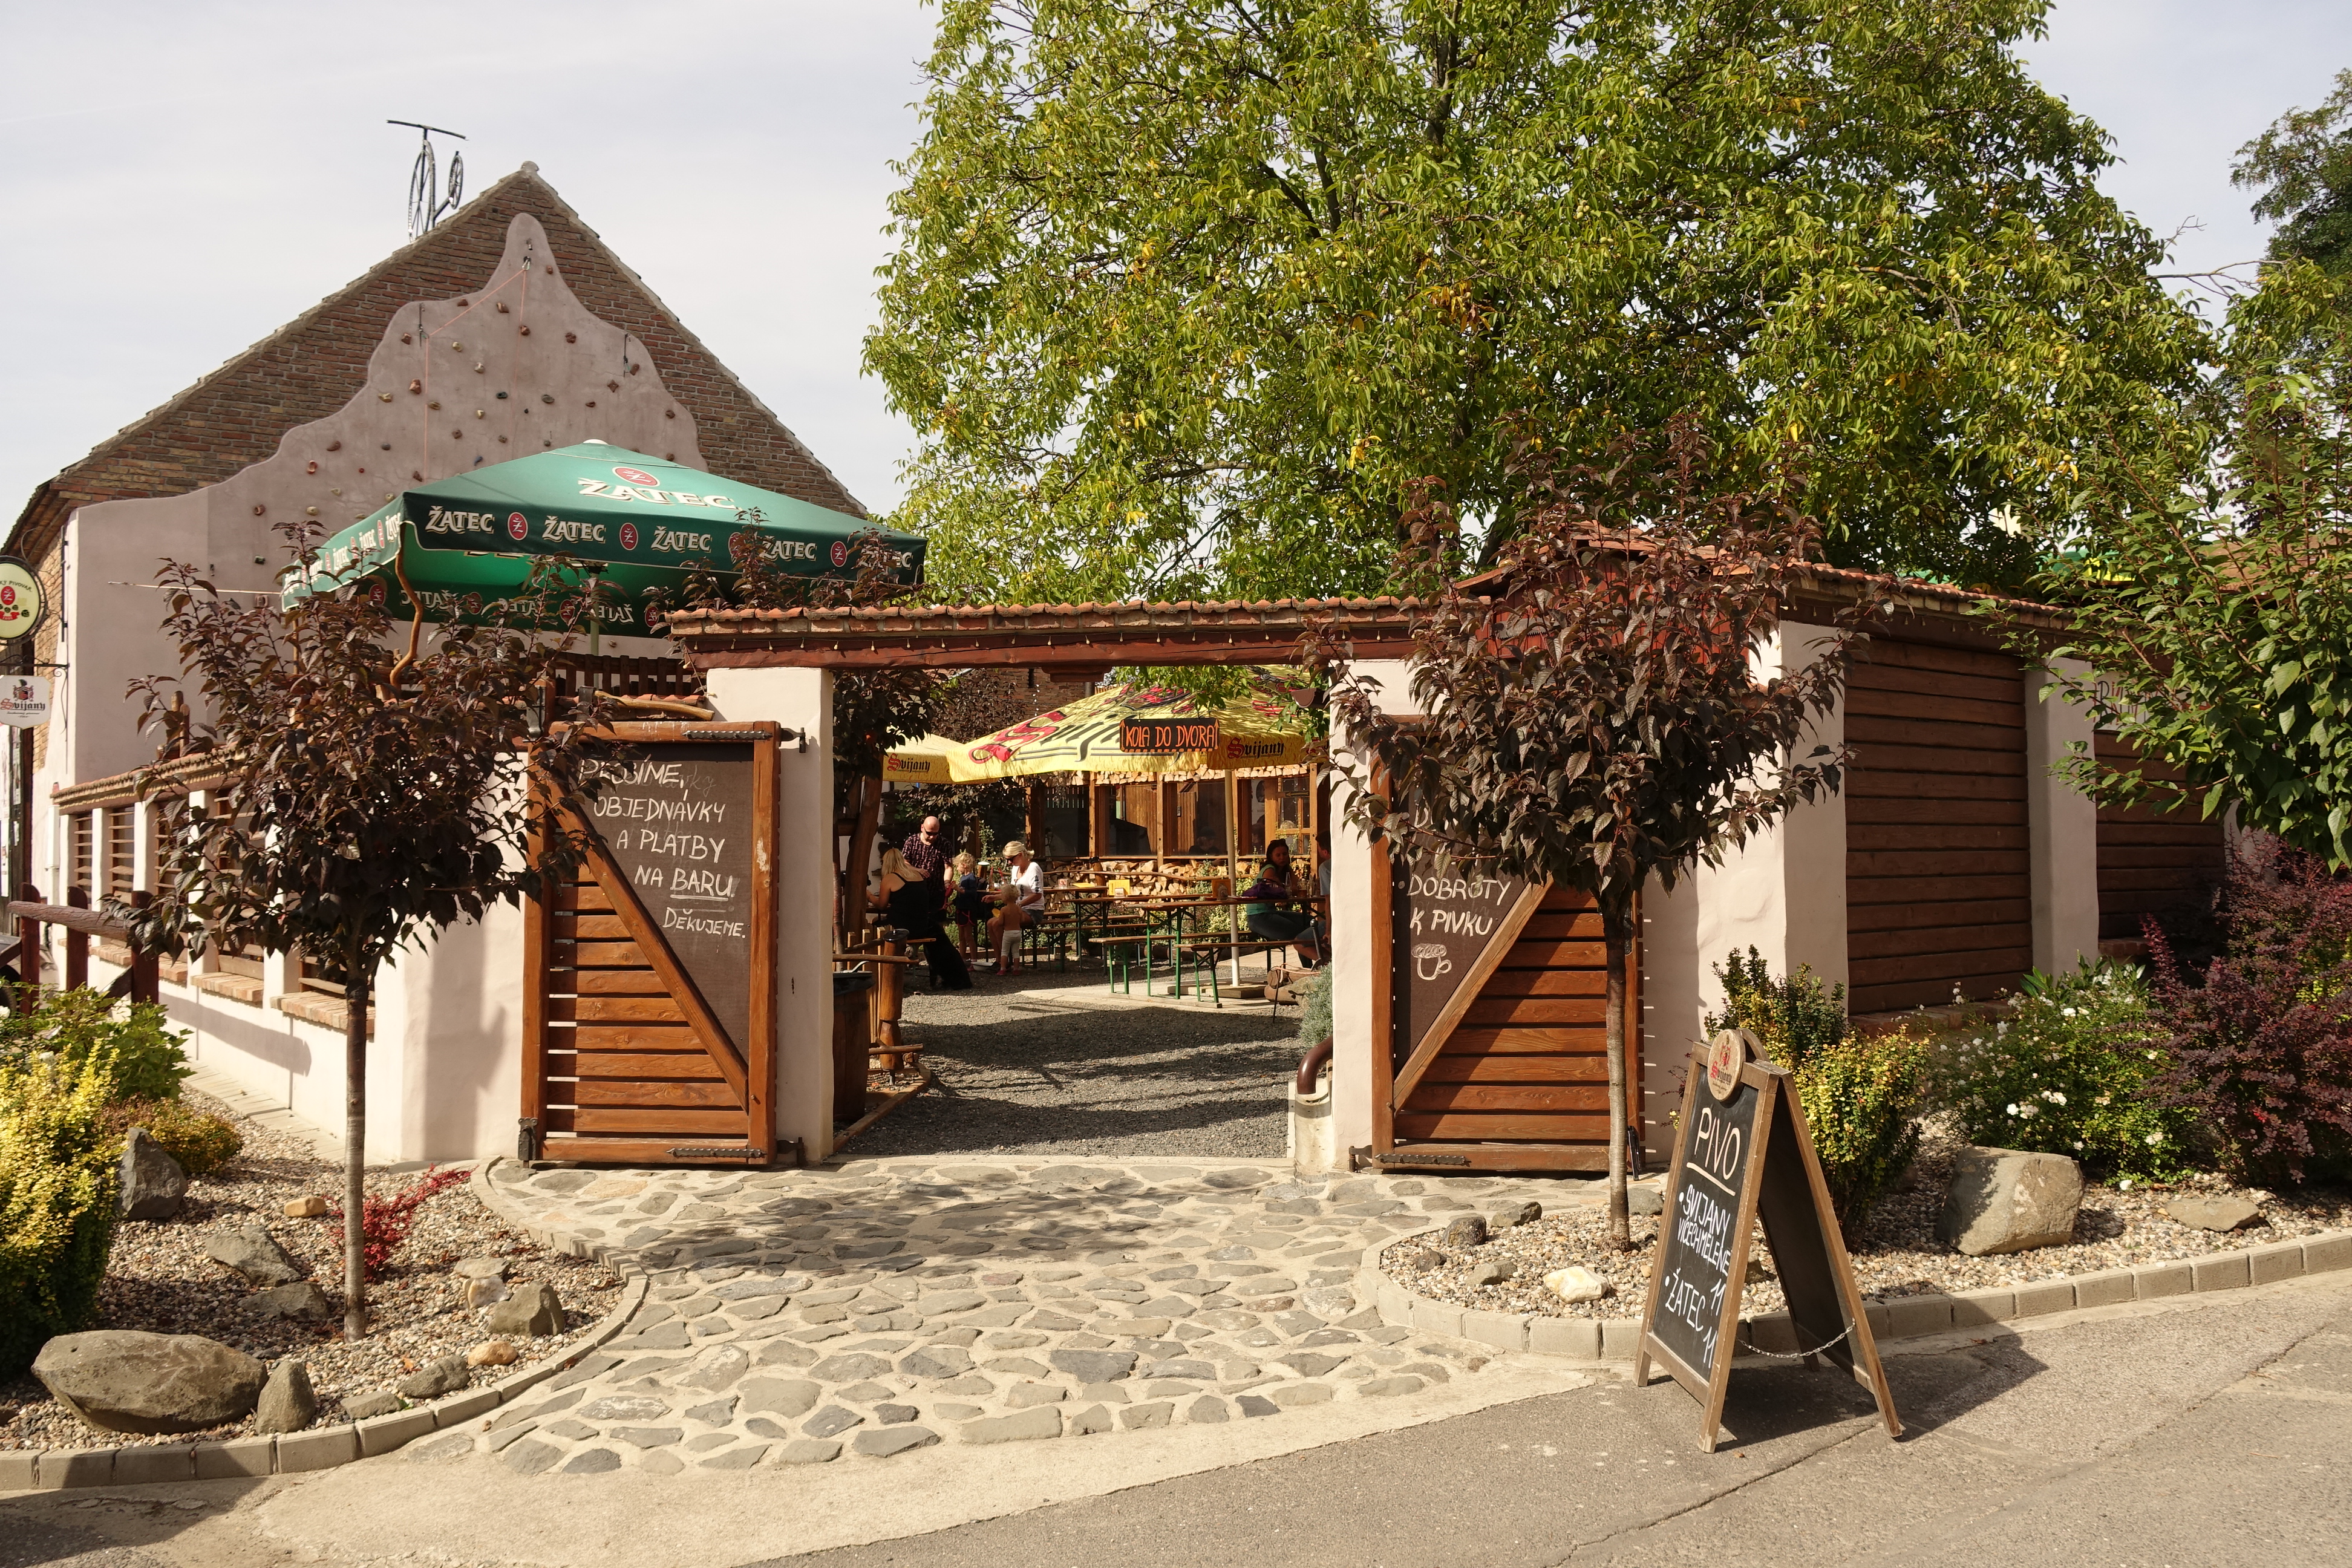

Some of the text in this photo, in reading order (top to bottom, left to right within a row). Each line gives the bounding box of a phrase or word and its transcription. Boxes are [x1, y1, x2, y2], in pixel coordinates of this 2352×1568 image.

[578, 477, 742, 511] ŽATEC
[425, 506, 495, 534] ŽATEC
[542, 515, 606, 544] ŽATEC
[651, 526, 711, 553] ŽATEC
[760, 535, 817, 561] ŽATEC
[9, 580, 32, 592] PIVOVAR
[0, 698, 45, 711] Svijany
[1126, 725, 1215, 748] KOLA DO DVORA
[1227, 737, 1284, 759] Svijany
[887, 753, 930, 773] Svijany
[593, 789, 725, 823] OBJEDNÁVKY
[616, 829, 725, 863] A PLATBY
[635, 865, 664, 887] NA
[1406, 874, 1511, 906] DOBROTY
[1410, 907, 1493, 937] K PIVKU
[1710, 1060, 1733, 1084] Svijany
[1694, 1107, 1740, 1180] PIVO
[1683, 1184, 1731, 1249] SVIJANY
[1665, 1267, 1706, 1331] ŽATEC
